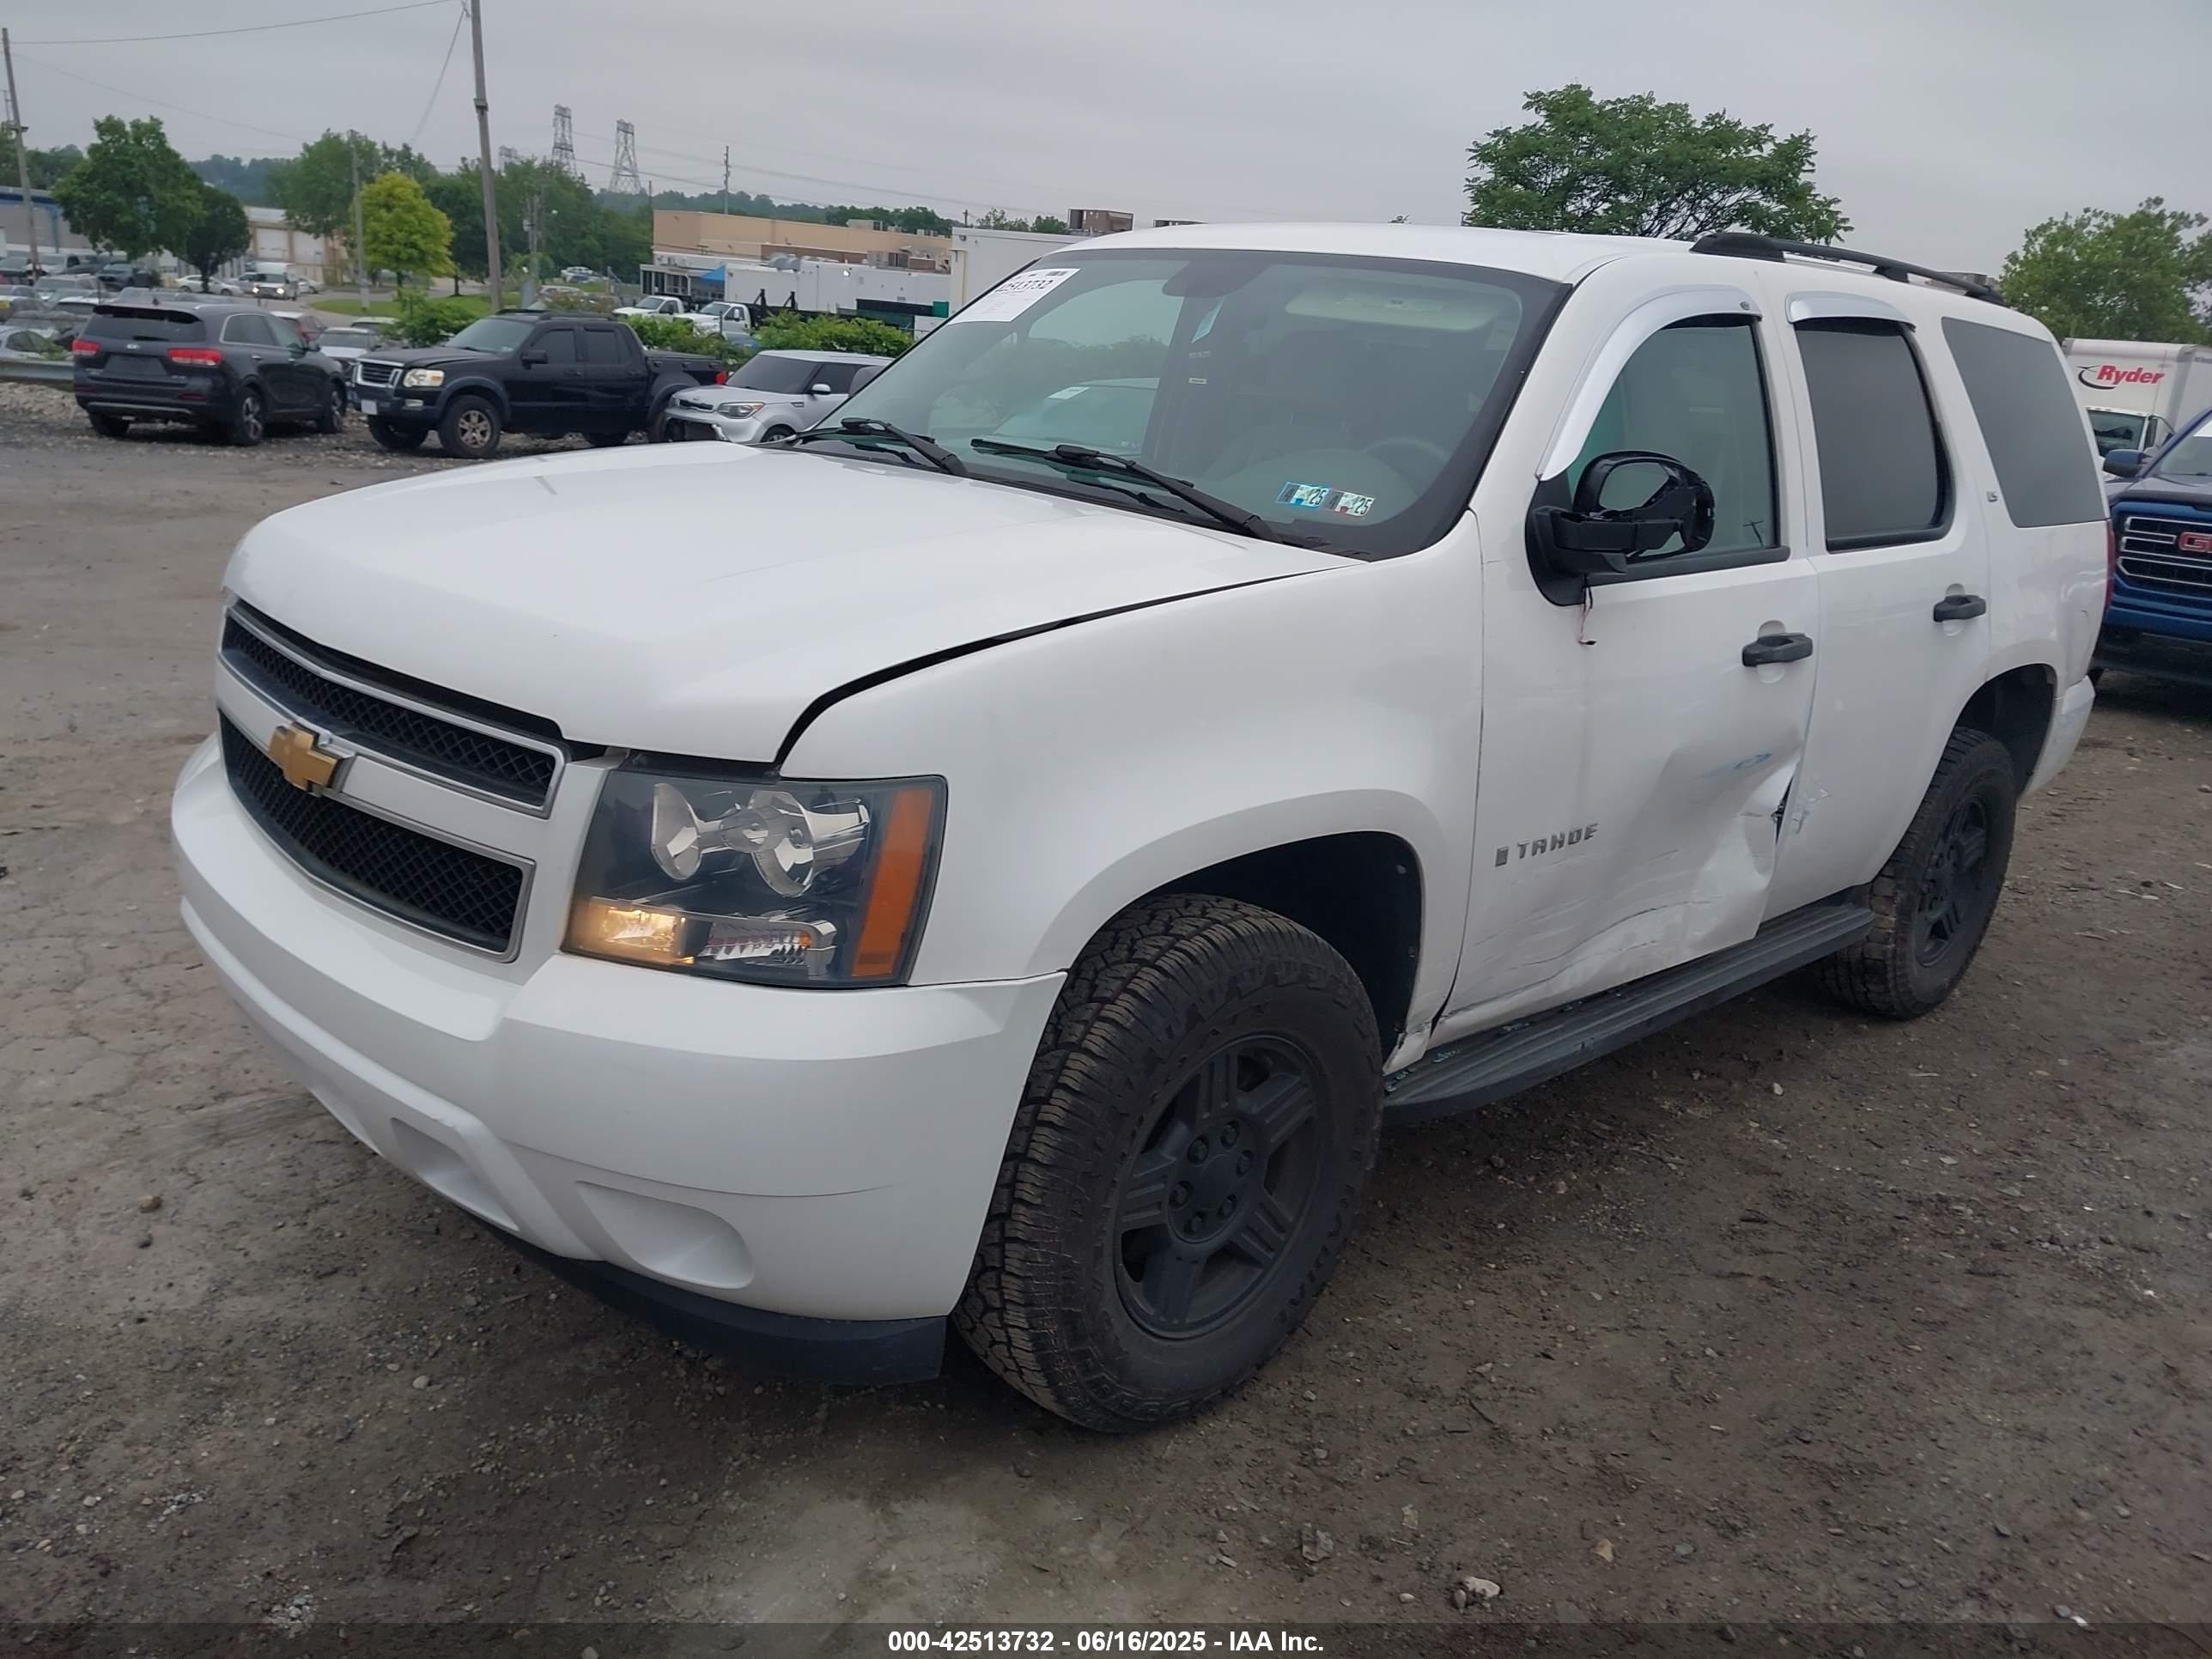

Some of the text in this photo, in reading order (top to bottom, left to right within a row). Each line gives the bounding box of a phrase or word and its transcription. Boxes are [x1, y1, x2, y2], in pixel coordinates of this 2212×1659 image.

[2097, 365, 2166, 386] Ryder
[1310, 489, 1328, 505] 25
[1354, 497, 1373, 515] 25
[1516, 823, 1599, 860] TAHOE
